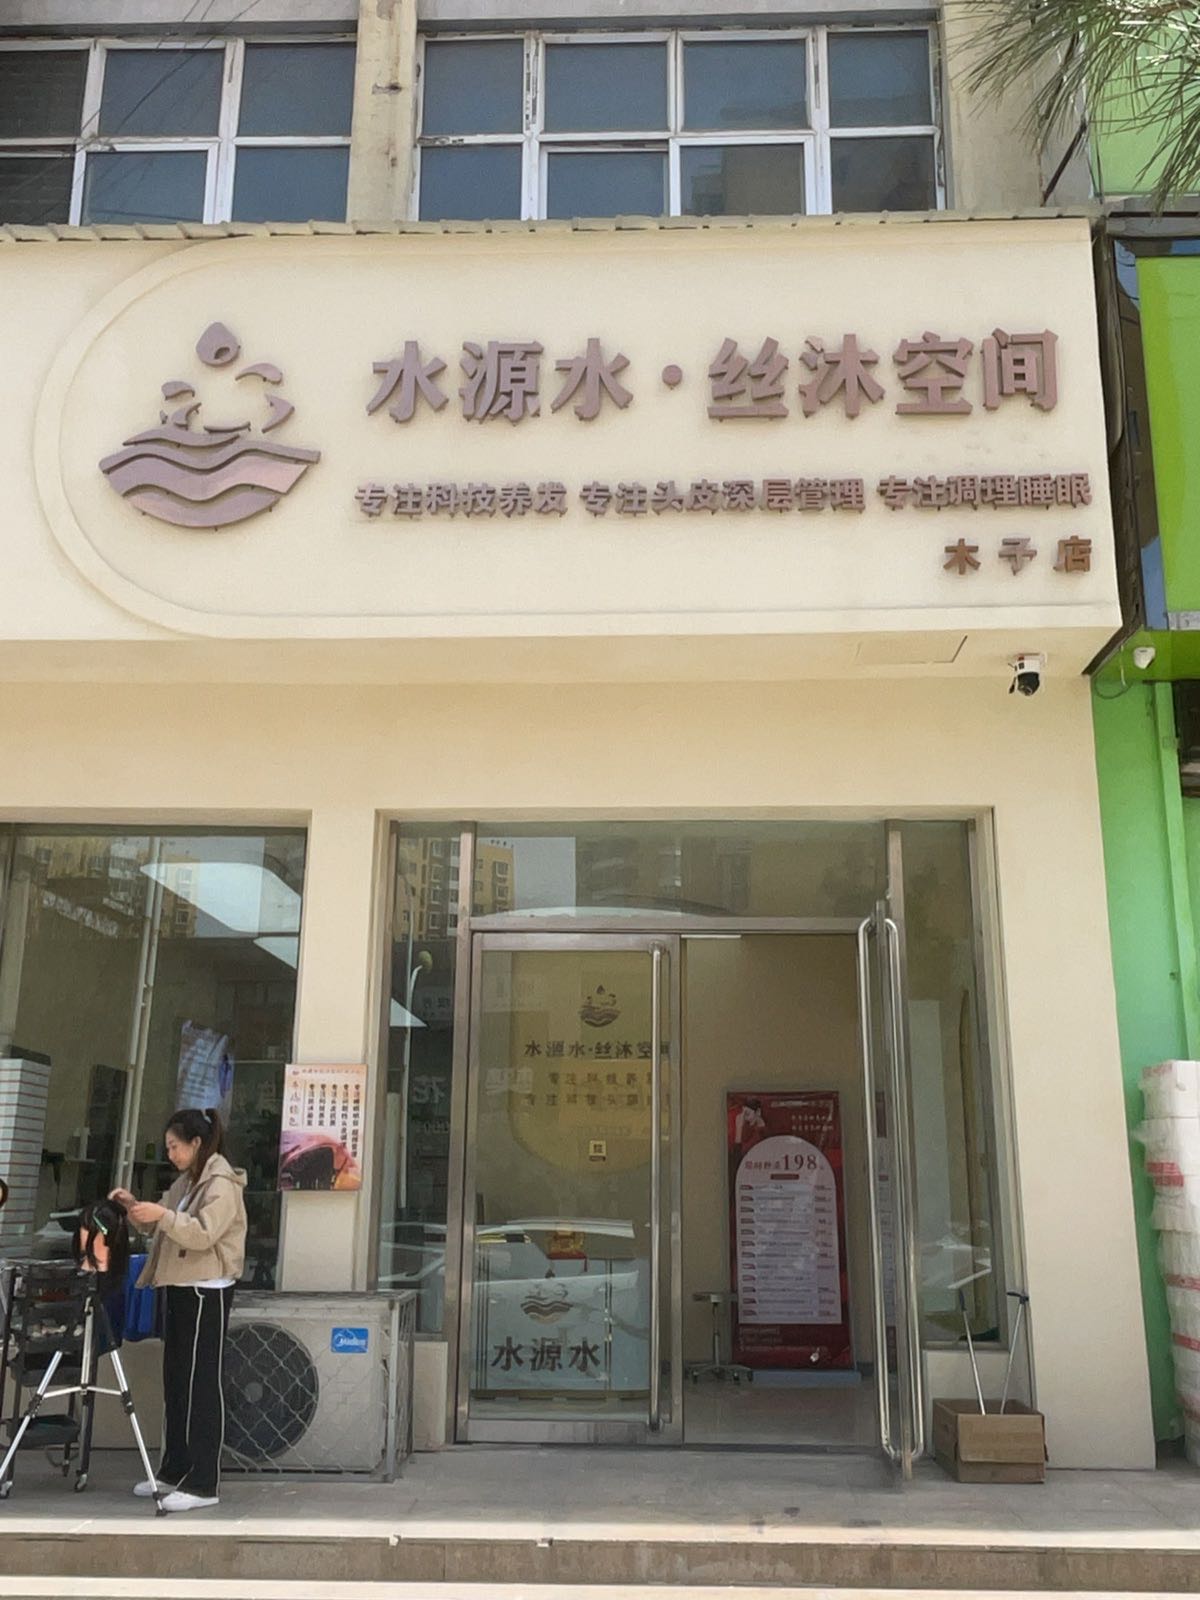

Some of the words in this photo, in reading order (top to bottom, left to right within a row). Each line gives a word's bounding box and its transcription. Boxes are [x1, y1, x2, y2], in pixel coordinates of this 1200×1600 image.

[367, 327, 1059, 426] 水源水·丝沐空间
[354, 481, 568, 517] 专注科技养发
[579, 477, 866, 516] 专注头皮深层管理
[877, 473, 1093, 511] 专注调理睡眠
[943, 535, 1092, 576] 木子店
[782, 1154, 818, 1171] 198
[491, 1336, 601, 1372] 水源水
